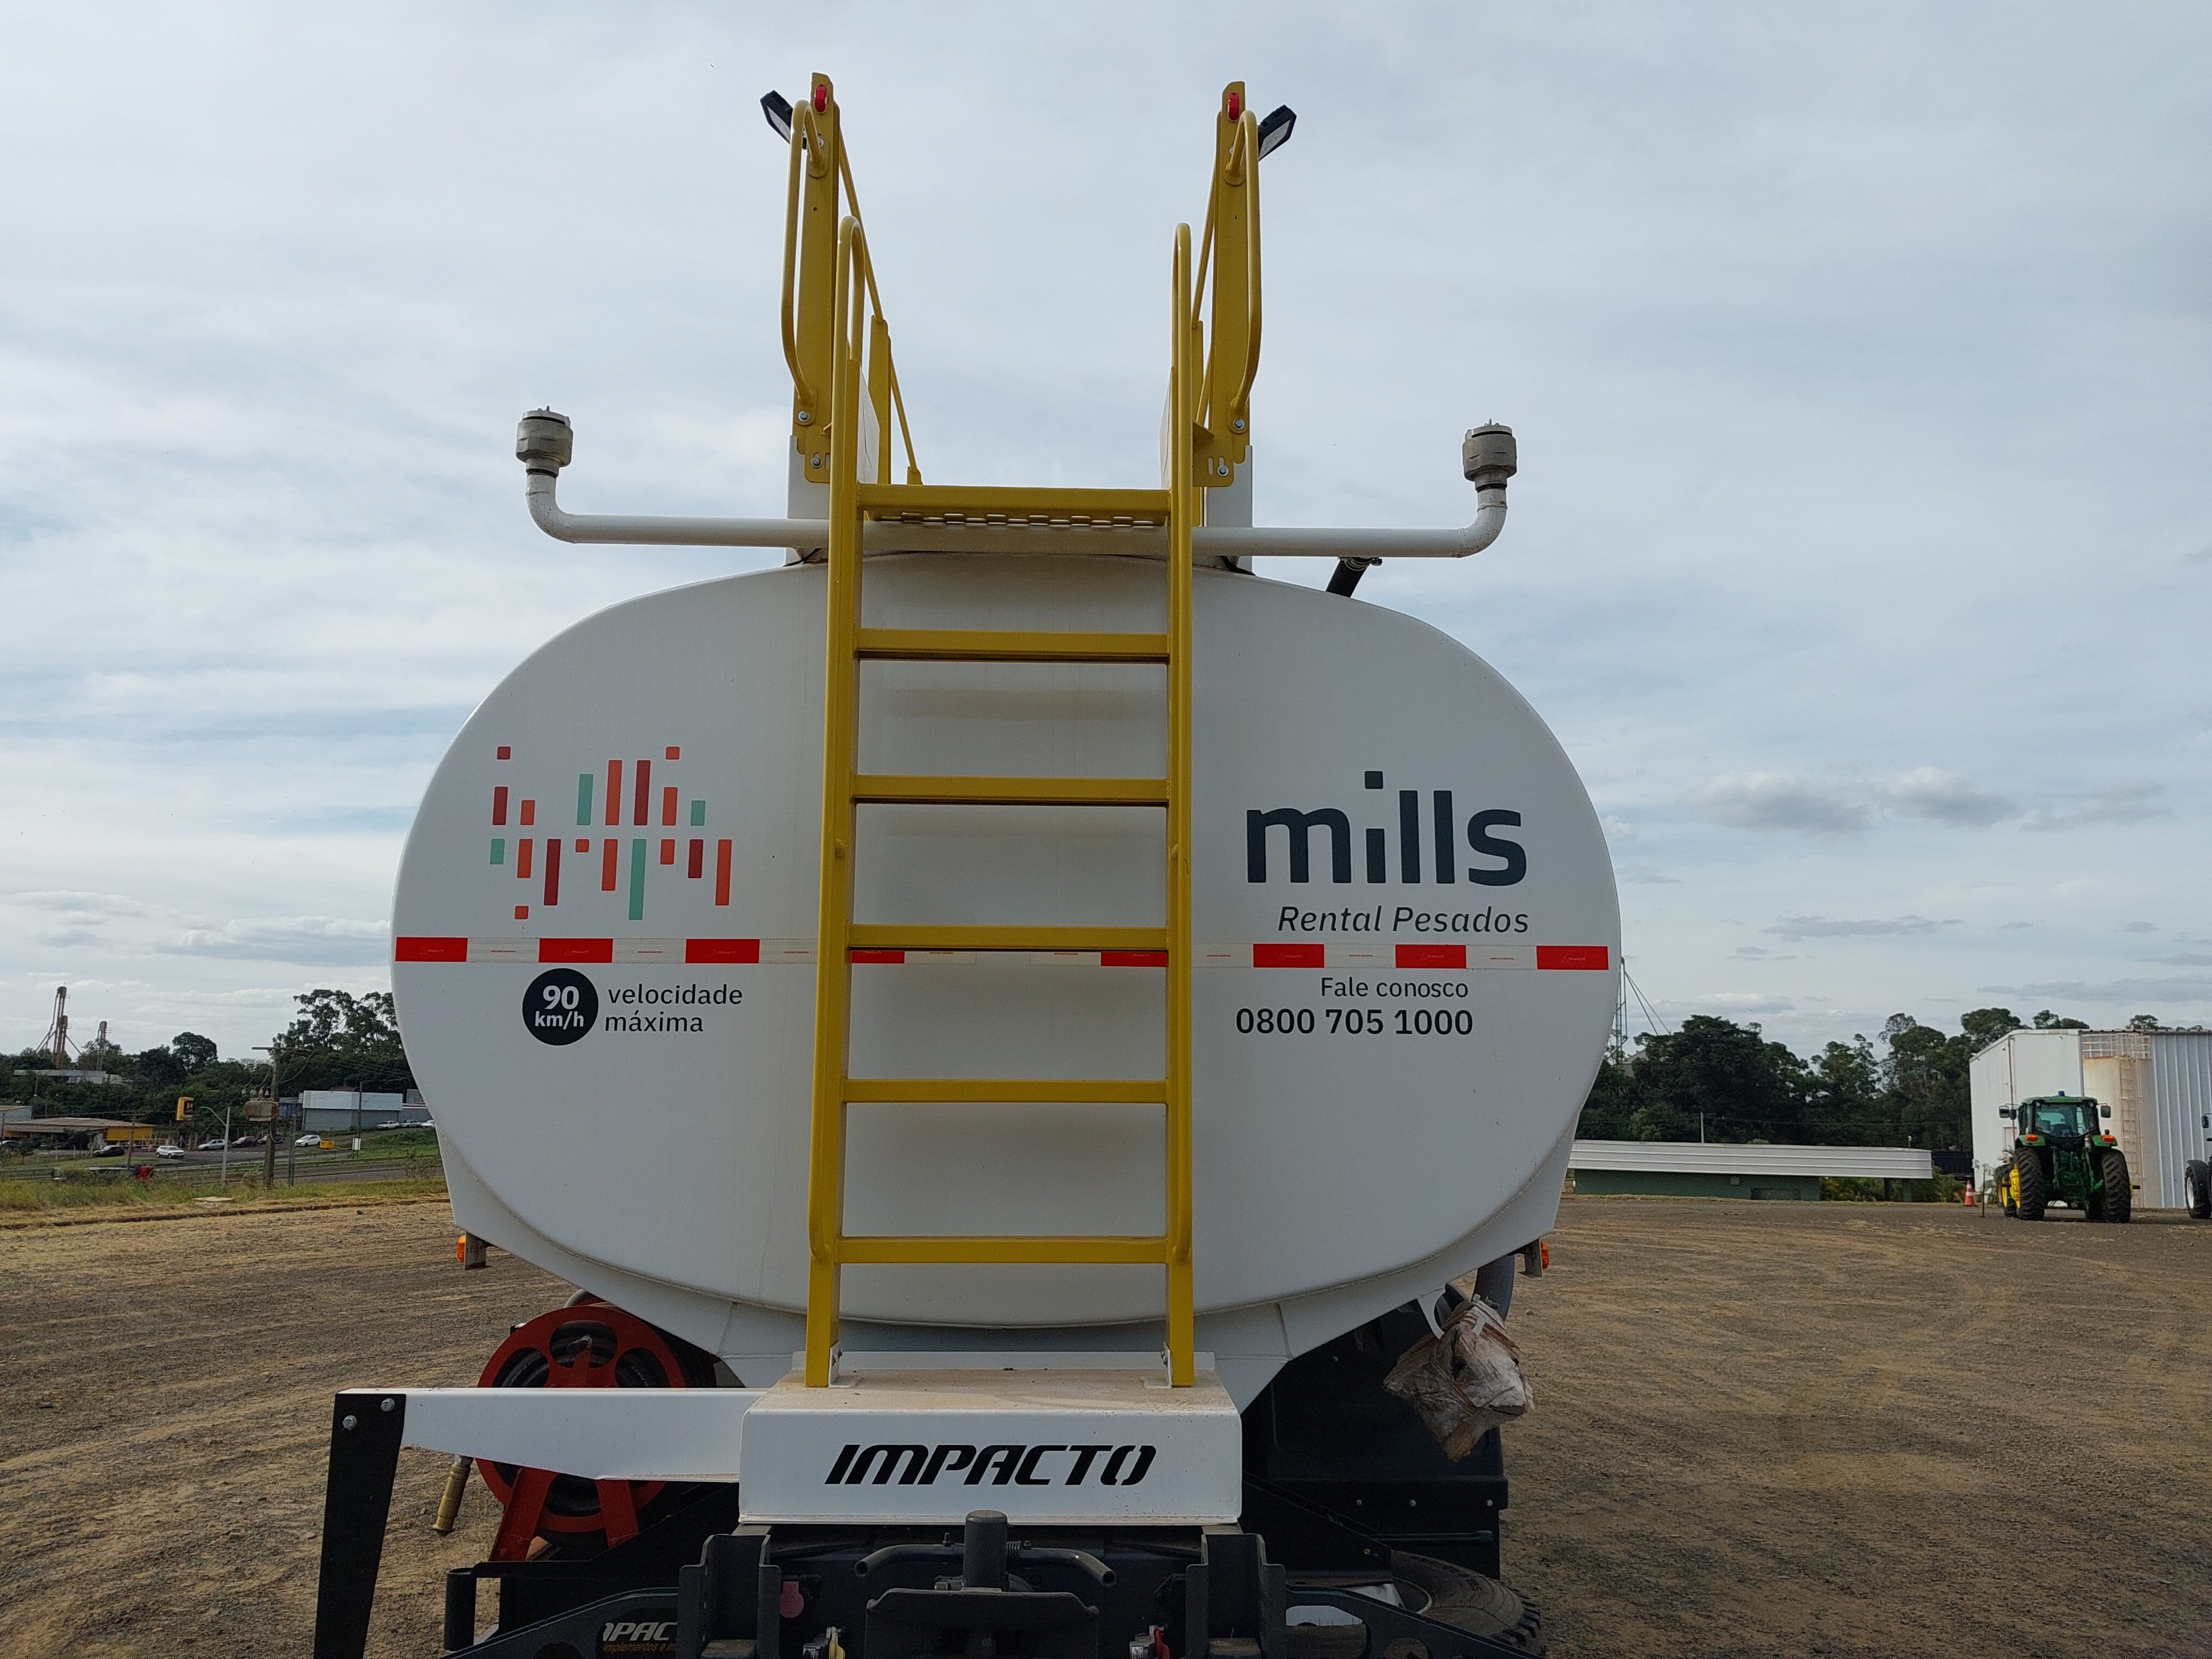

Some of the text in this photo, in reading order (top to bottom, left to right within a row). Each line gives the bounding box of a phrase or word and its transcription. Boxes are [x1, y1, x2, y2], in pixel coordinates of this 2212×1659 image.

[1246, 770, 1527, 887] mills
[1278, 906, 1529, 933] Rental Pesados
[543, 985, 579, 1010] 90
[608, 983, 743, 1005] velocidade
[1321, 976, 1469, 998] Fale conosco
[535, 1010, 585, 1031] km/h
[605, 1010, 704, 1032] máxima
[1236, 1007, 1473, 1035] 0800 705 1000
[824, 1444, 1157, 1486] IMPACTO
[603, 1642, 658, 1653] implementos
